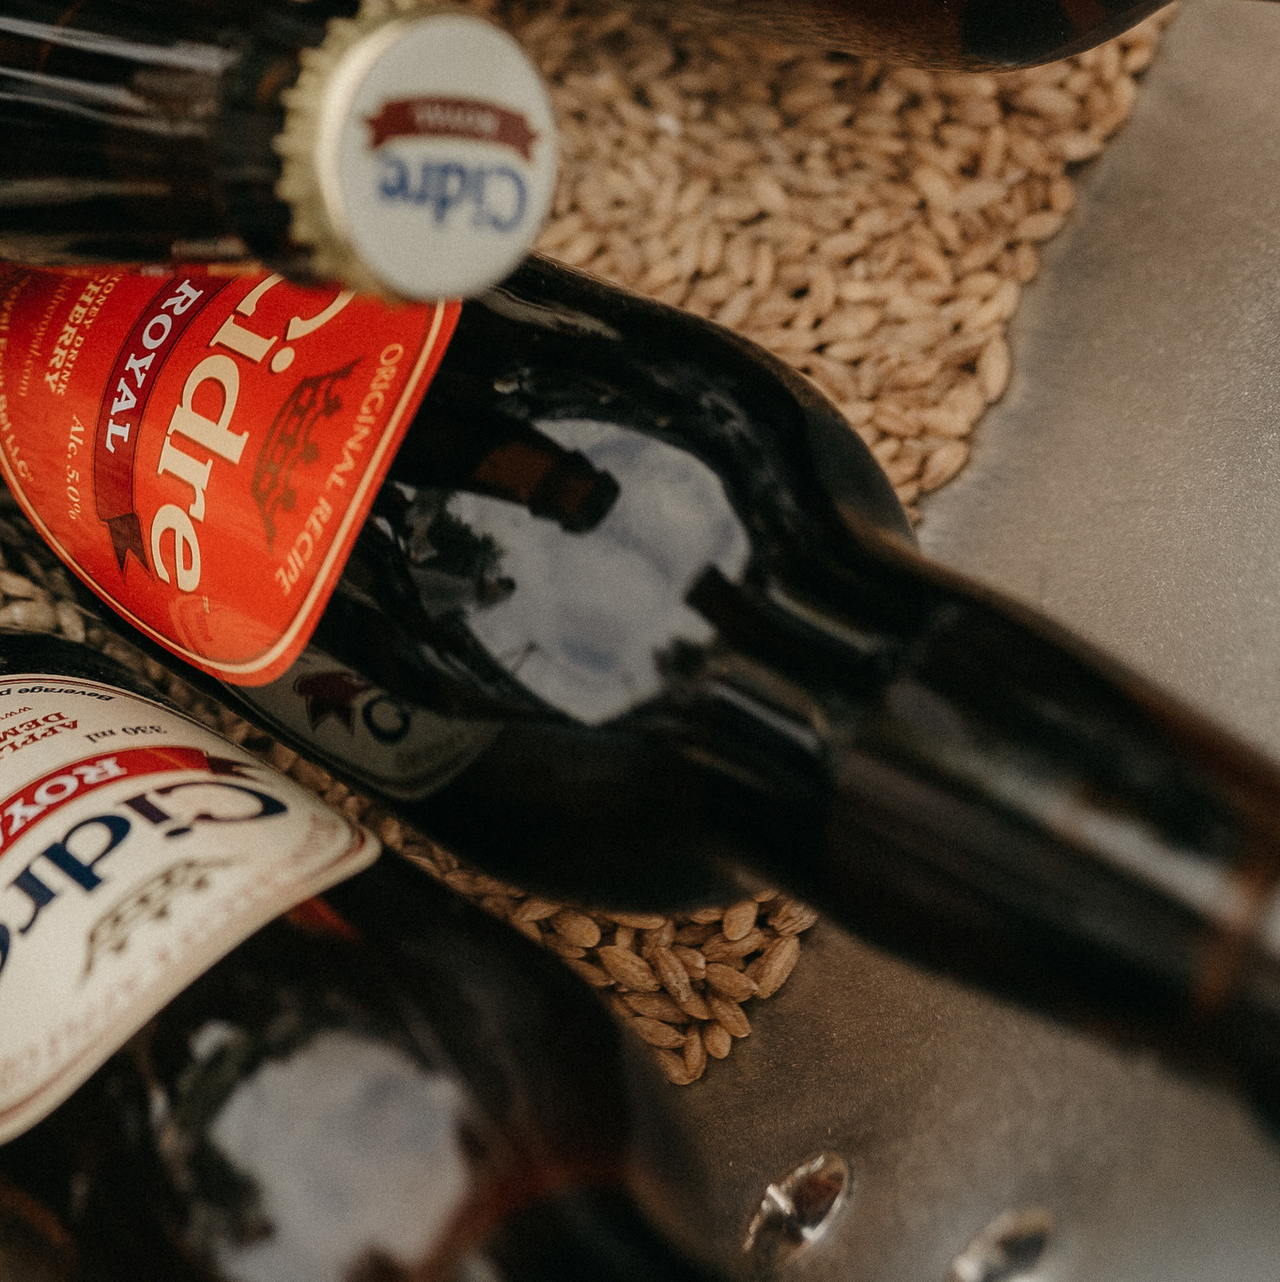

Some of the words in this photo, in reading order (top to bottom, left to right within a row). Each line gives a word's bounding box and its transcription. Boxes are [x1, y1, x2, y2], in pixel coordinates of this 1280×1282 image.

[55, 335, 85, 396] DRINK
[105, 279, 204, 453] ROYAL
[66, 413, 86, 459] Alc.
[151, 273, 356, 593] Cidre
[325, 342, 404, 488] ORIGINAL
[65, 464, 82, 521] 5.0%
[274, 495, 333, 596] RECIPE
[18, 685, 116, 703] Beverage
